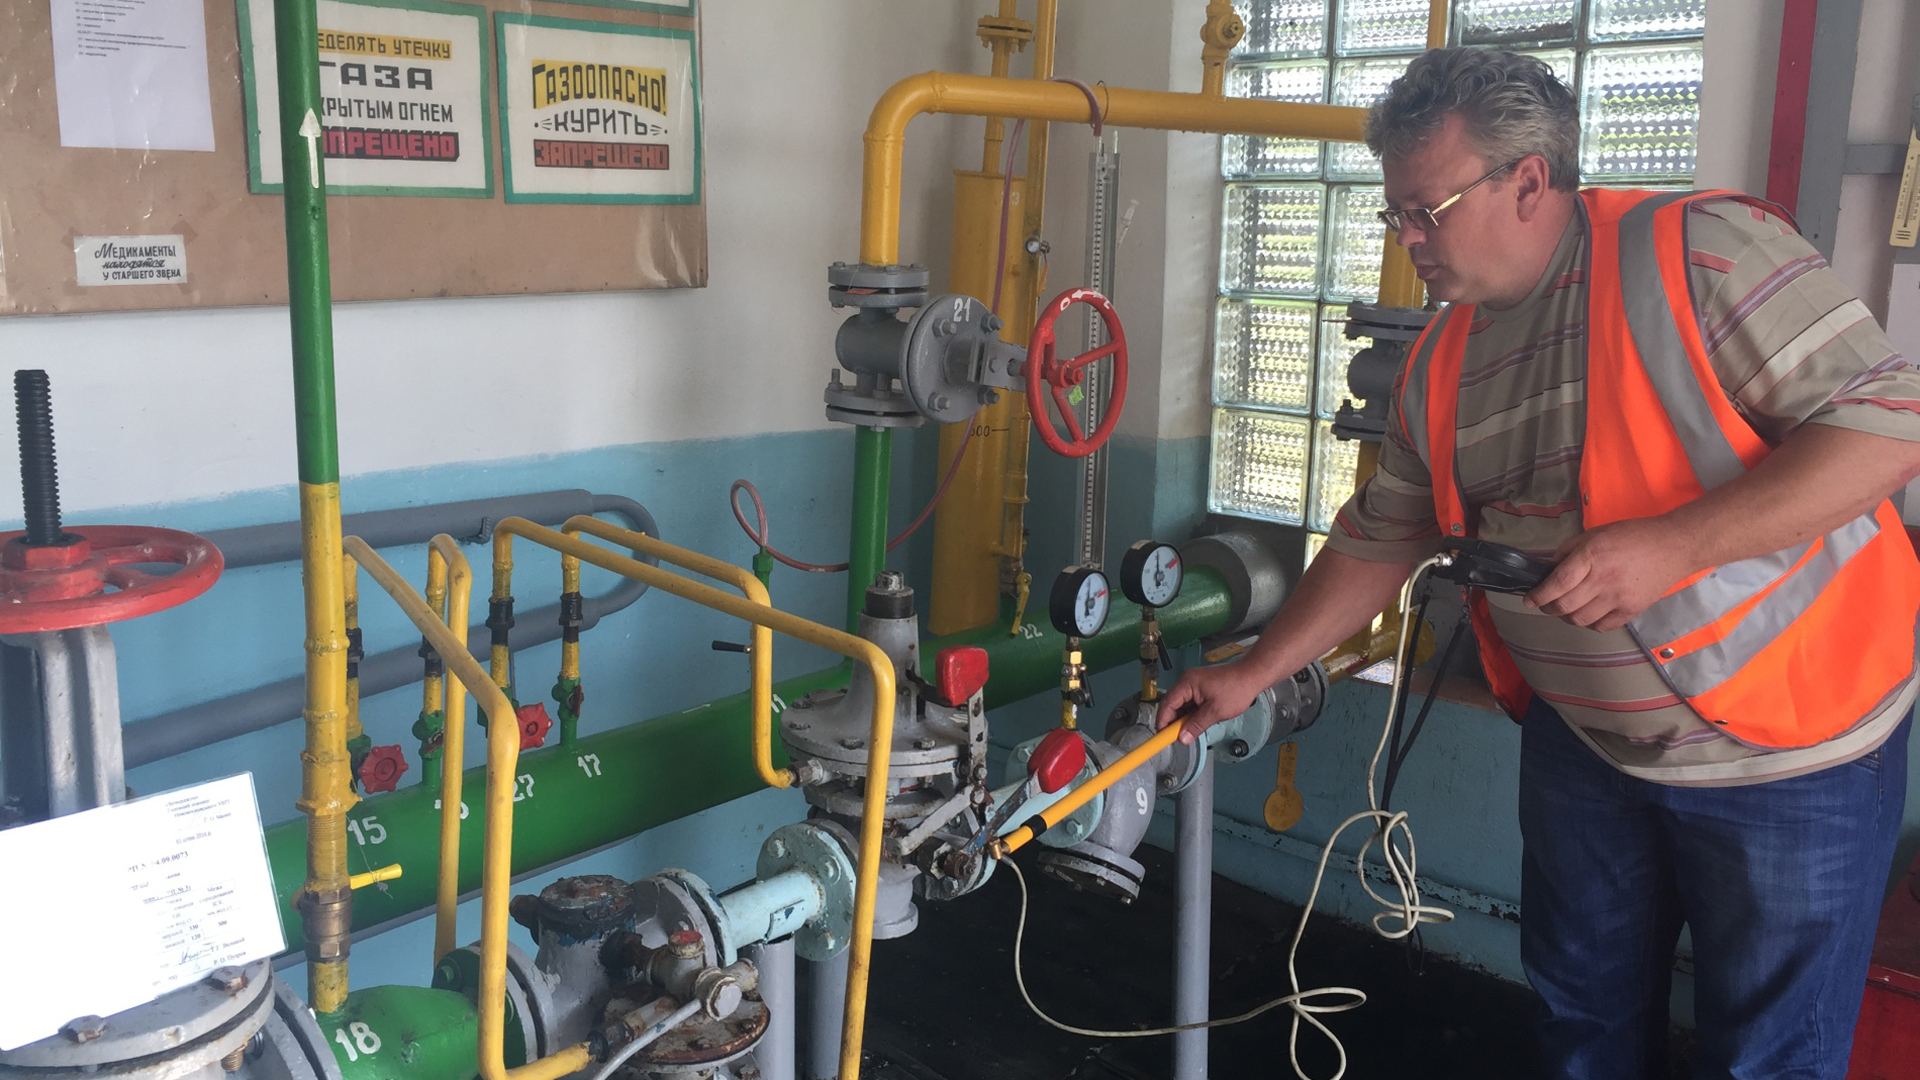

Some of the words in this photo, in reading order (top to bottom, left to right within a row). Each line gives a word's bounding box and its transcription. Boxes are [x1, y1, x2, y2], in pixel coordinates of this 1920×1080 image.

[394, 40, 450, 59] УТЕЧКУ
[532, 63, 667, 116] ГАЗООПАСНО!
[398, 101, 454, 122] ОГНЕМ
[554, 108, 648, 136] КУРИТЬ
[94, 242, 176, 260] МЕДИКАМЕНТЫ
[102, 258, 166, 270] находятся
[112, 270, 154, 280] СТАРШЕГО
[156, 268, 182, 281] ЗВЕНА
[954, 298, 970, 322] 21
[1018, 623, 1043, 640] 22
[577, 753, 602, 778] 17
[1136, 786, 1148, 815] 9
[348, 815, 387, 846] 15
[334, 1021, 382, 1062] 18
